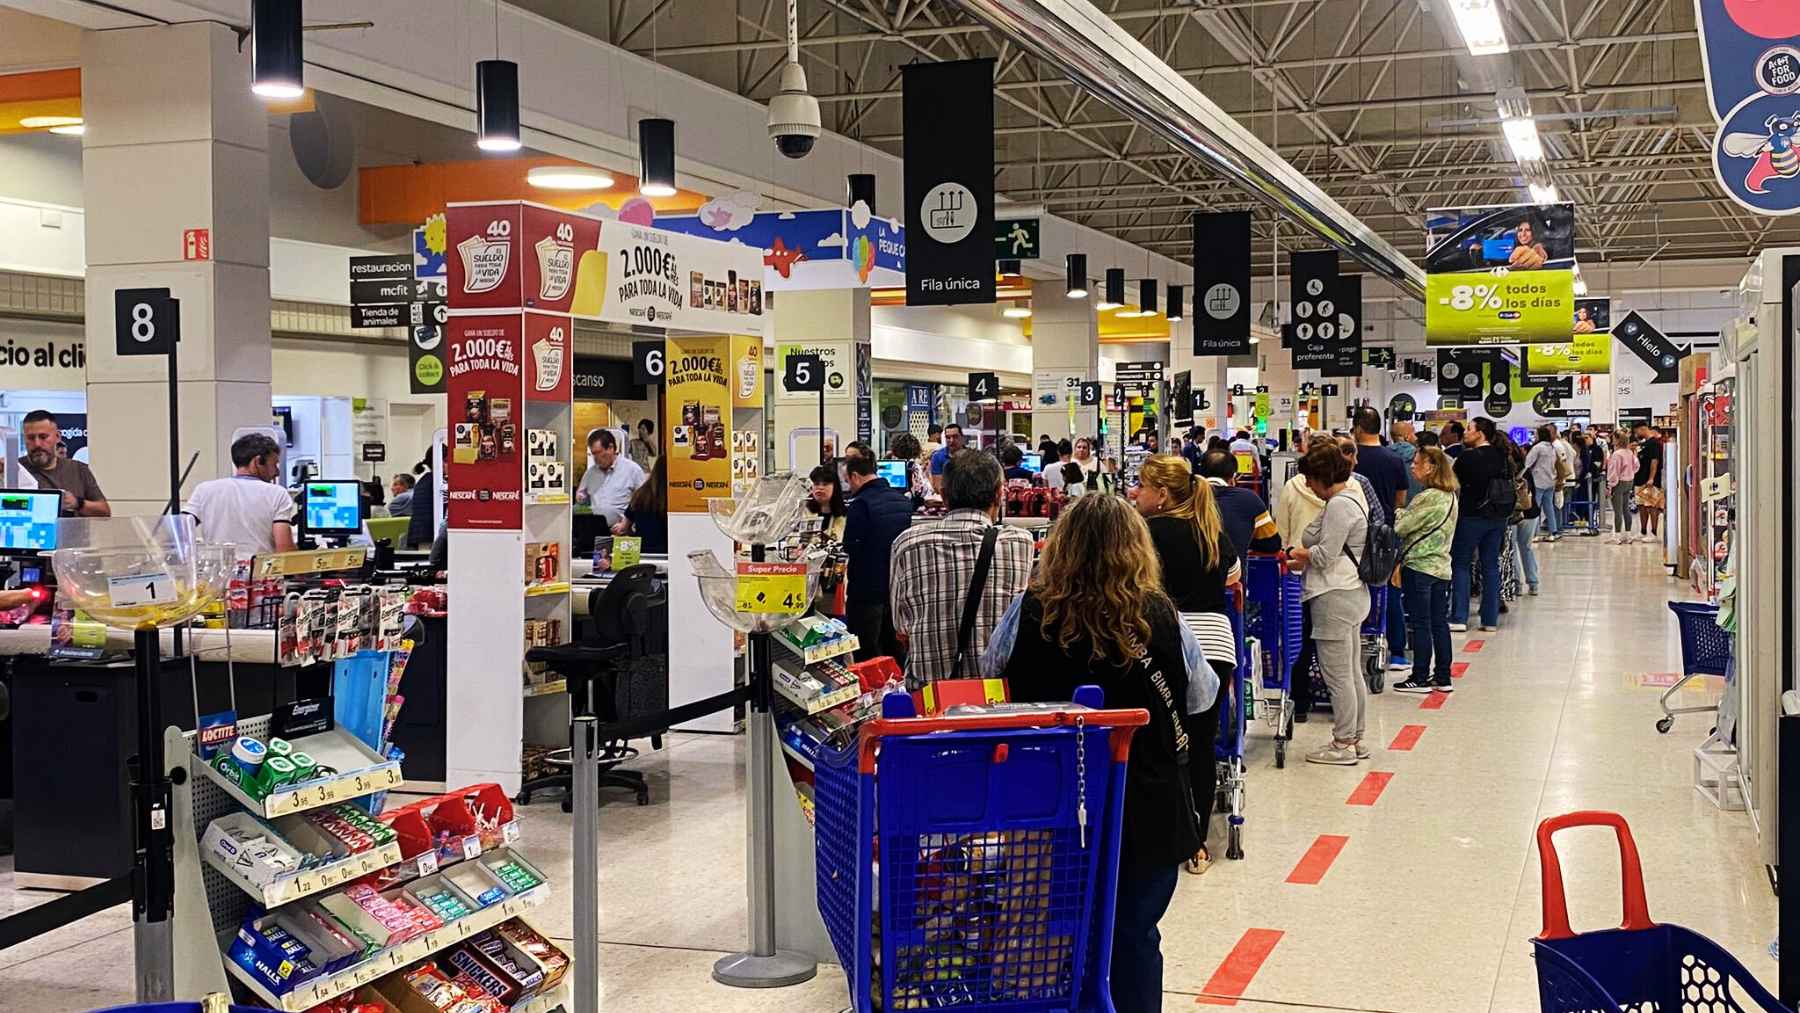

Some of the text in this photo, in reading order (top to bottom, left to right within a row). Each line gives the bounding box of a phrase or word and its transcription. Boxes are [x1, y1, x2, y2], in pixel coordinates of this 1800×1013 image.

[1771, 71, 1796, 86] FOOD
[1772, 64, 1790, 79] FOR
[486, 219, 511, 237] 40
[556, 222, 574, 242] 40
[878, 226, 886, 237] LA
[473, 254, 504, 263] SUELDO
[482, 268, 500, 277] VIDA
[380, 285, 408, 296] mcfit
[921, 277, 980, 291] Fila única
[618, 279, 684, 311] PARA TODA LA VIDA
[1439, 283, 1547, 312] -8% todos
[1505, 297, 1561, 309] los días
[360, 308, 387, 318] Tienda
[388, 308, 400, 317] de
[131, 302, 155, 343] 8
[362, 317, 398, 326] animales
[549, 326, 564, 342] 40
[1203, 339, 1241, 348] Fila única
[1307, 344, 1324, 352] Caja
[1636, 333, 1661, 358] Hielo
[33, 341, 54, 367] al
[58, 343, 86, 369] cli
[790, 347, 836, 356] Nuestros
[449, 358, 520, 377] PARA TODA LA VIDA
[645, 350, 665, 376] 6
[668, 373, 728, 388] PARA TODA LA VIDA
[795, 361, 810, 385] 5
[975, 378, 988, 396] 4
[1084, 386, 1094, 401] 3
[1326, 386, 1332, 395] 1
[1115, 388, 1122, 403] 2
[1194, 393, 1200, 407] 1
[449, 489, 477, 500] NESCAFÉ
[492, 489, 520, 500] NESCAFÉ
[747, 564, 798, 574] Super Precio
[145, 581, 156, 600] 1
[292, 703, 320, 716] Energizer
[201, 725, 236, 742] LOCTITE
[220, 762, 240, 781] Orbit
[255, 960, 282, 986] HALLS
[450, 950, 509, 997] SNICKERS
